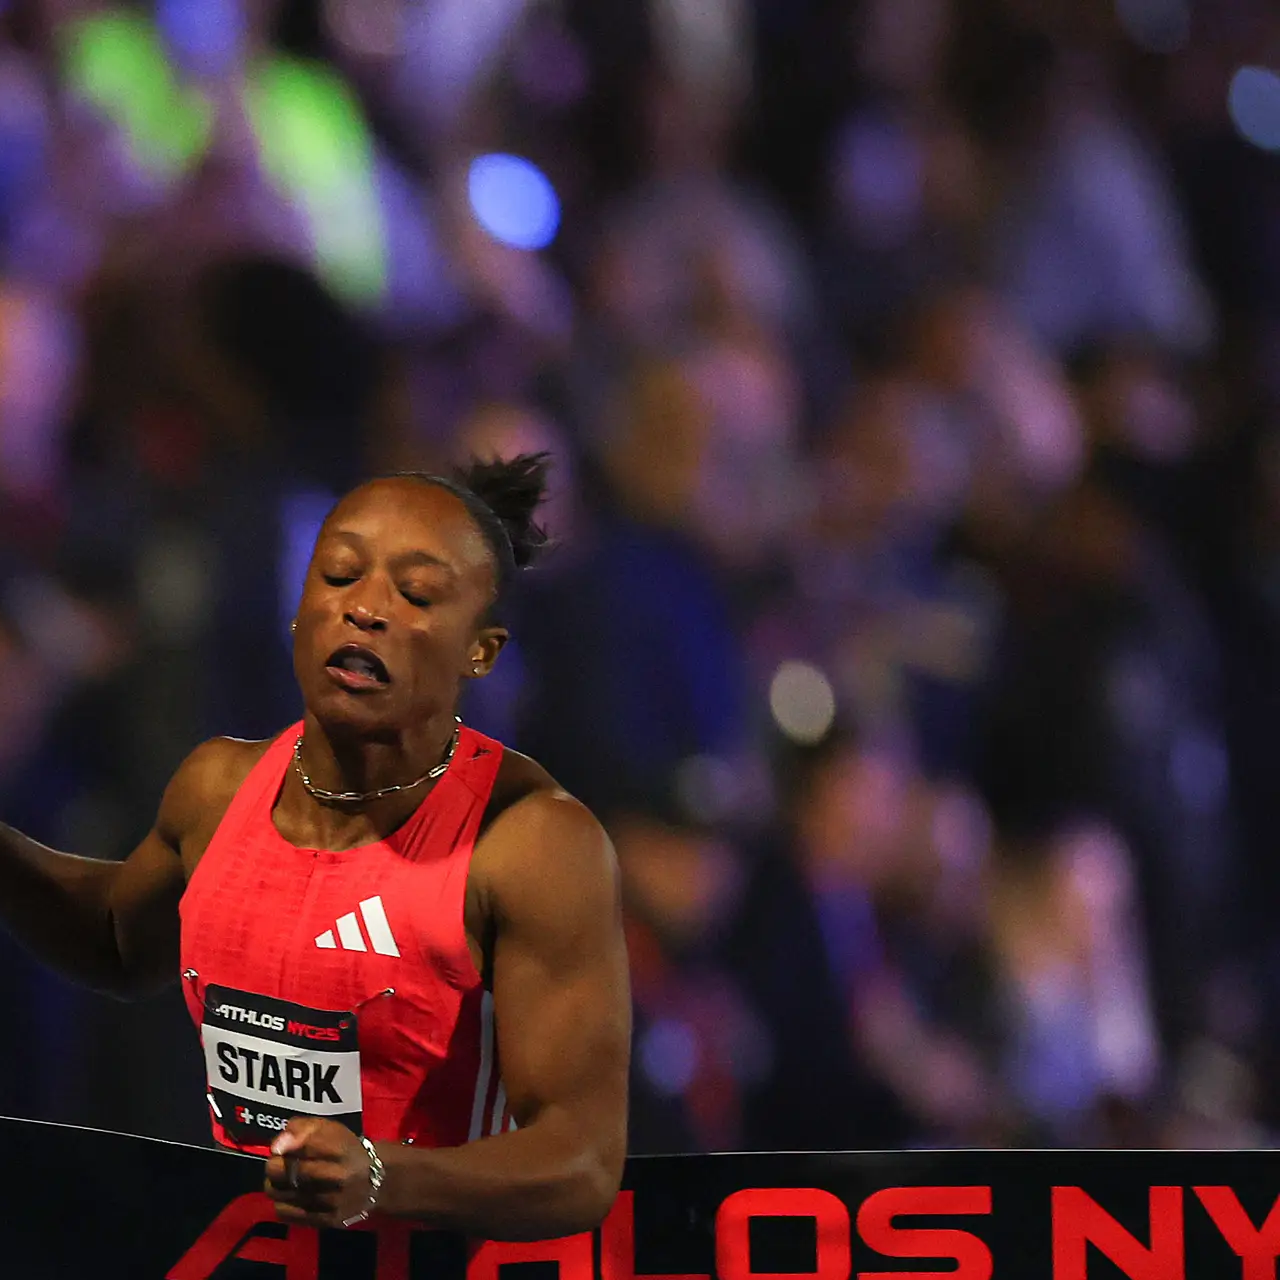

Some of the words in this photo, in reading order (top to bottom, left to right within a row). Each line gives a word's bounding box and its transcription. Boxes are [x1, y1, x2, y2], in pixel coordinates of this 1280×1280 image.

[216, 1004, 286, 1031] ATHLOS
[287, 1020, 341, 1042] NYC25
[216, 1041, 343, 1104] STARK
